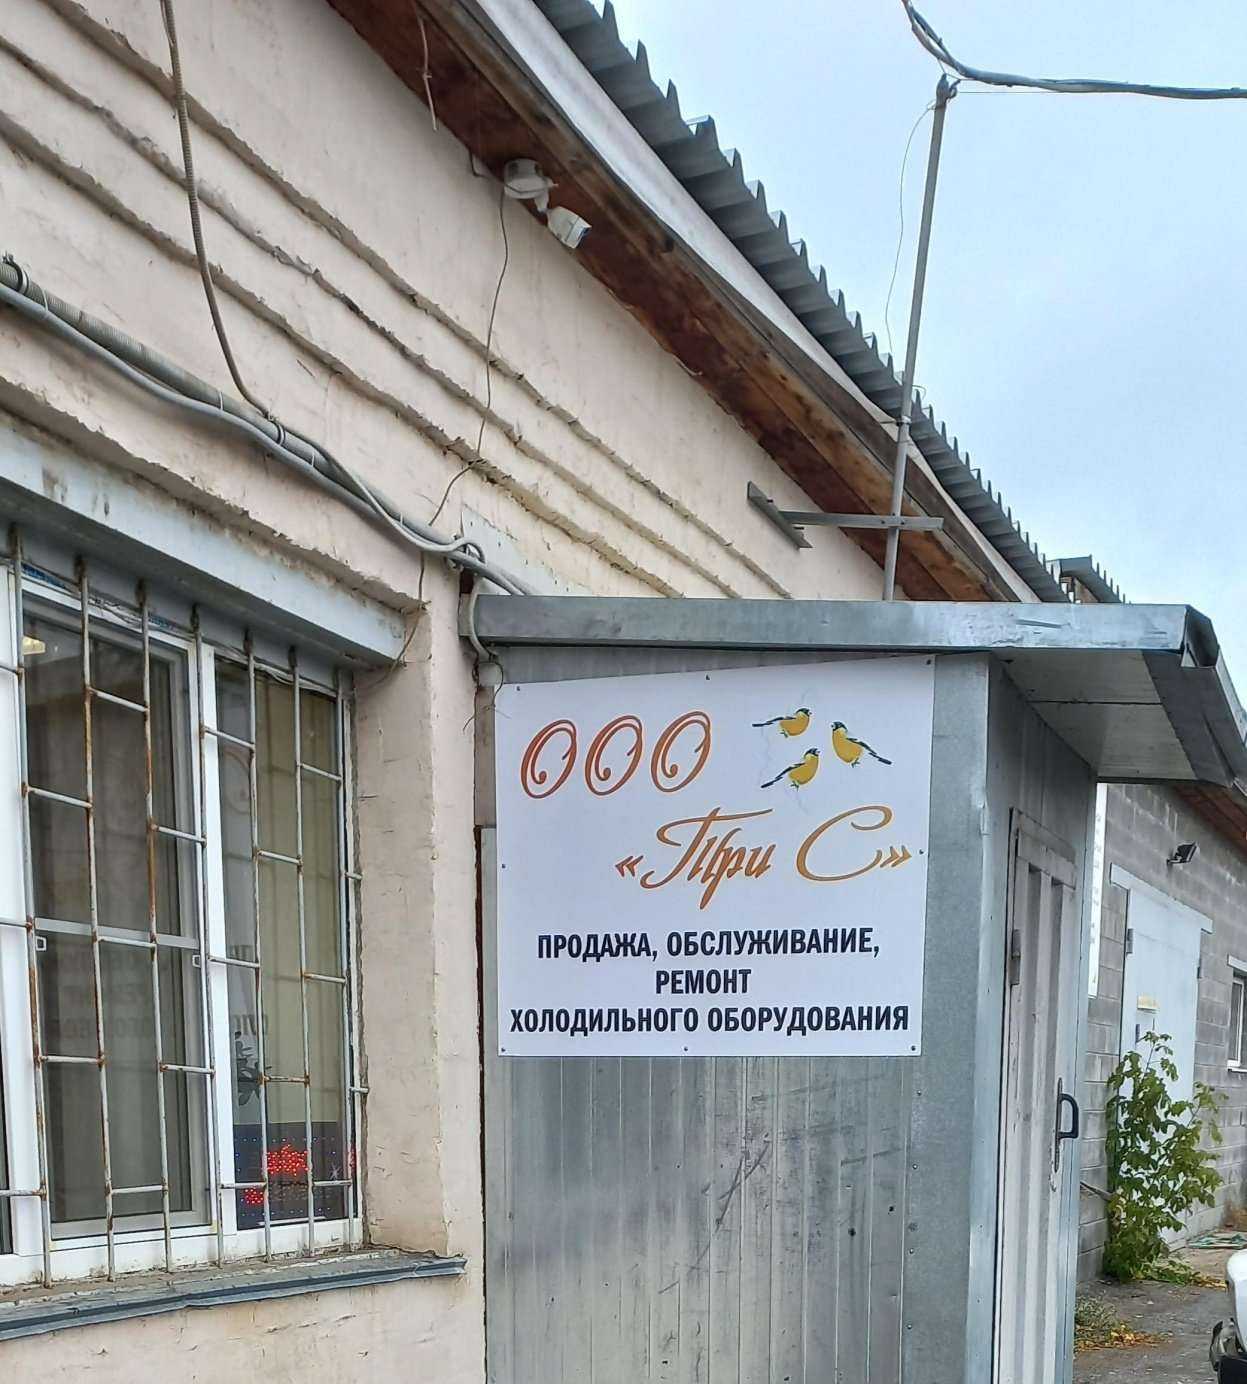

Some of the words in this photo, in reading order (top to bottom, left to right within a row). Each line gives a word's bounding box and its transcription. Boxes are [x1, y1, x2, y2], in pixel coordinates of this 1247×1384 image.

[520, 711, 712, 799] ООО
[796, 805, 912, 881] С»
[538, 933, 658, 961] ПРОДАЖА,
[667, 927, 880, 959] ОБСЛУЖИВАНИЕ,
[655, 969, 751, 994] РЕМОНТ
[510, 1008, 699, 1036] ХОЛОДИЛЬНОГО
[707, 1005, 909, 1035] ОБОРУДОВАНИЯ
